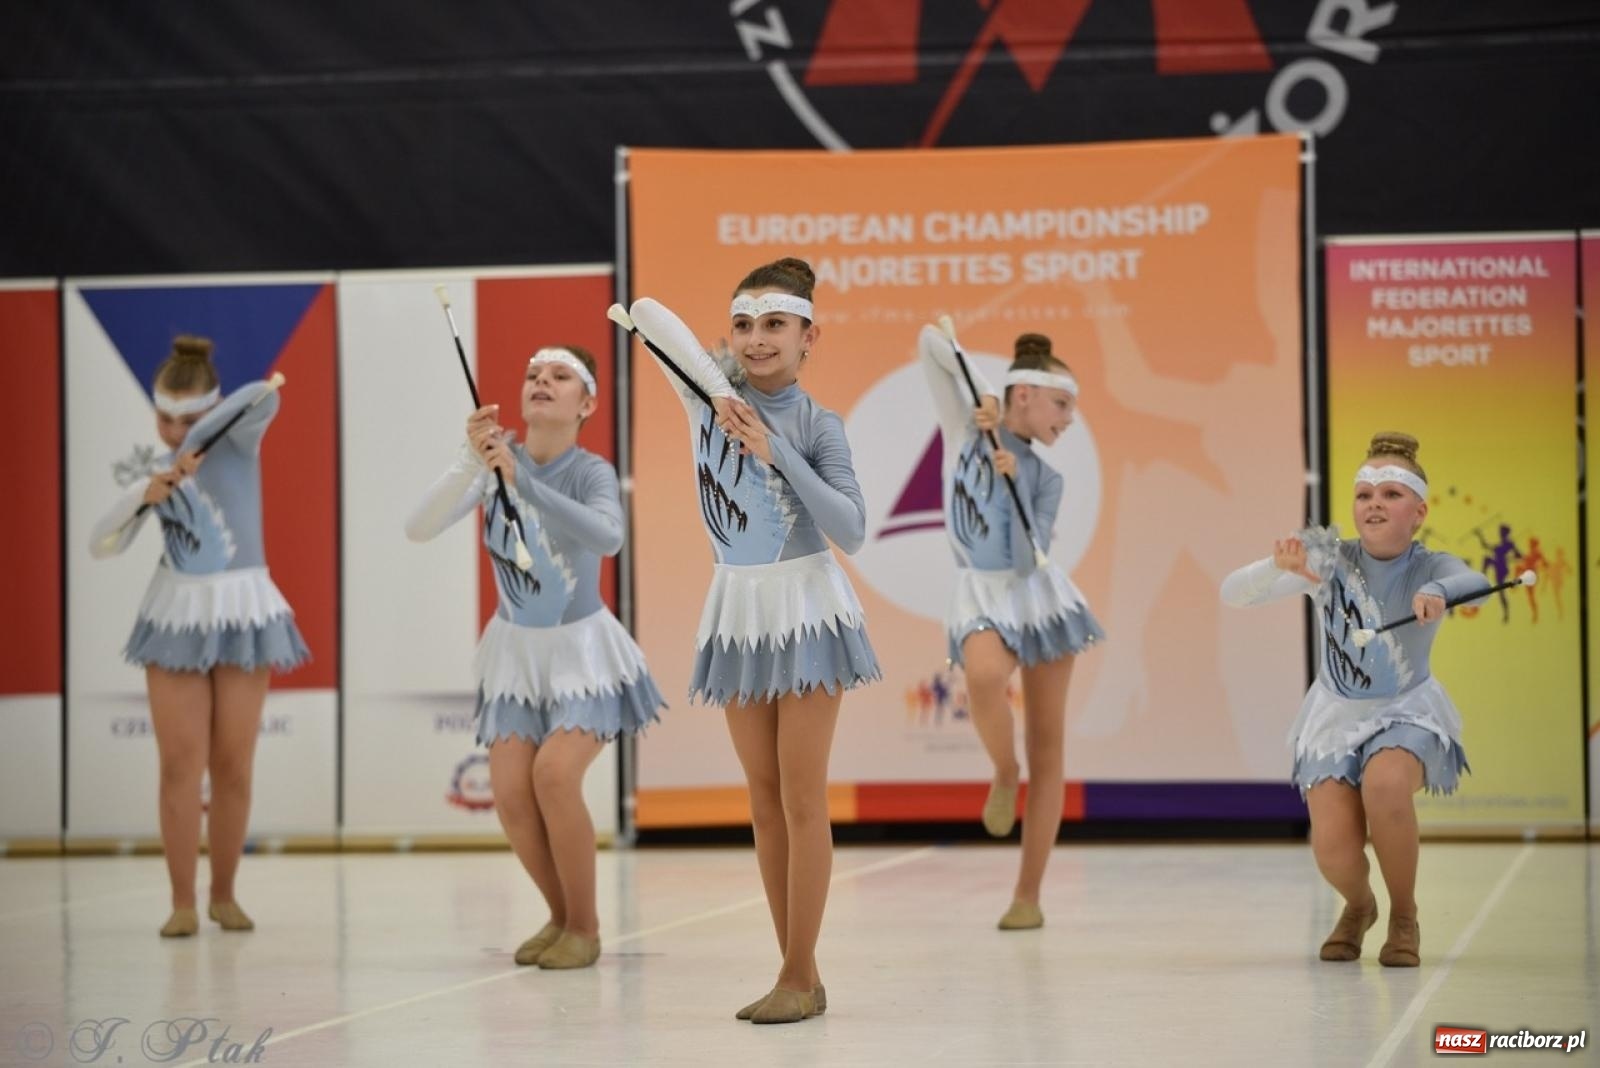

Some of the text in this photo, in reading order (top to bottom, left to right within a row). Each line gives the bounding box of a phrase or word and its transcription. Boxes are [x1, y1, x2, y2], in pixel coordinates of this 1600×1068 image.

[717, 203, 1210, 246] EUROPEAN CHAMPIONSHIP
[1022, 248, 1143, 285] SPORT
[1349, 256, 1549, 281] INTERNATIONAL
[1371, 285, 1528, 310] FEDERATION
[1366, 314, 1533, 339] MAJORETTES
[1408, 345, 1492, 368] SPORT
